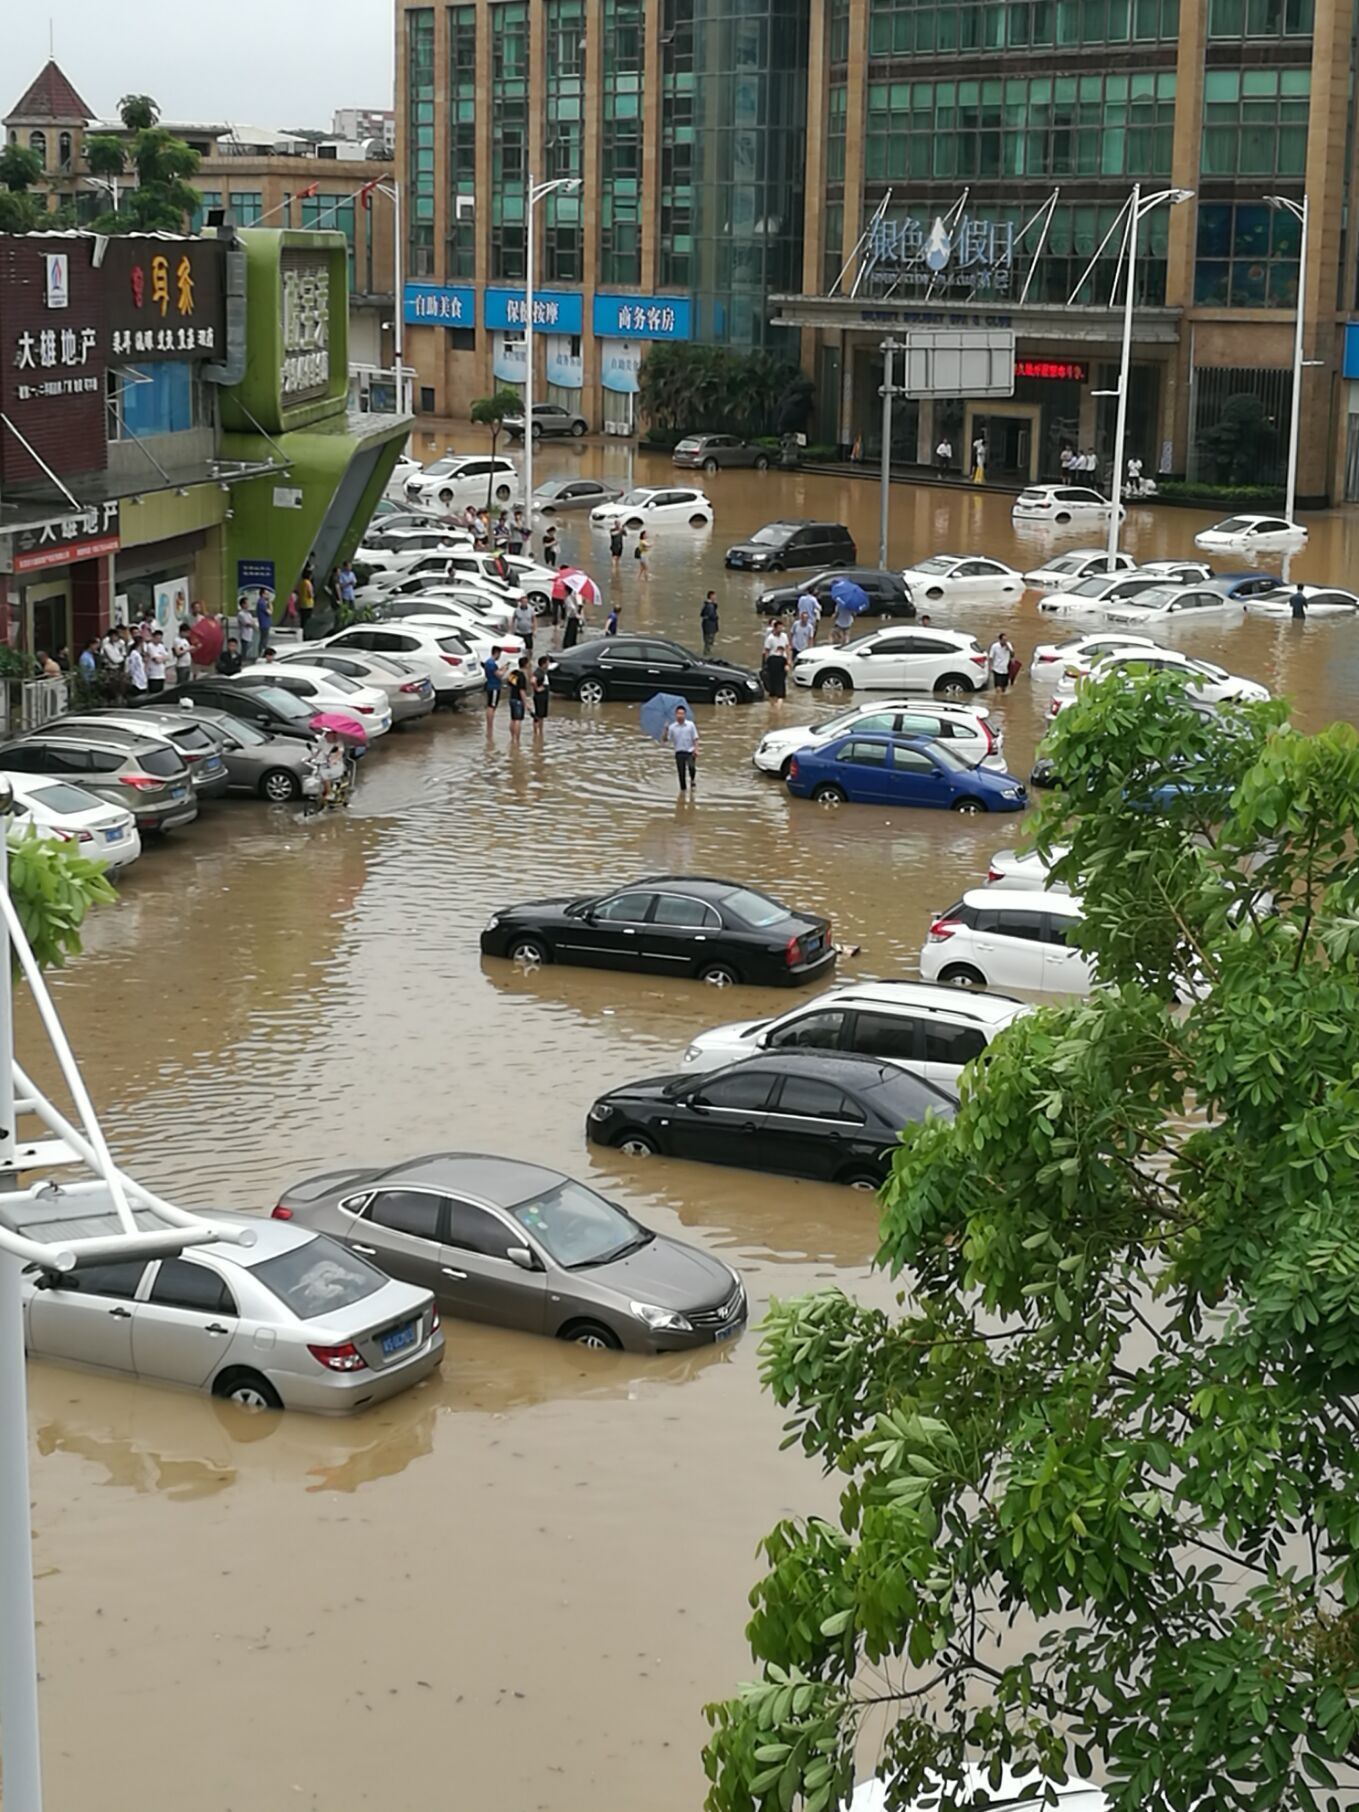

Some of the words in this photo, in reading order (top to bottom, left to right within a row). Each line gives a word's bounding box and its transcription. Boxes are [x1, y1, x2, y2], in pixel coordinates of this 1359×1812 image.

[415, 294, 462, 318] 自助美食
[618, 305, 675, 332] 商务客房
[18, 327, 97, 370] 大雄地产
